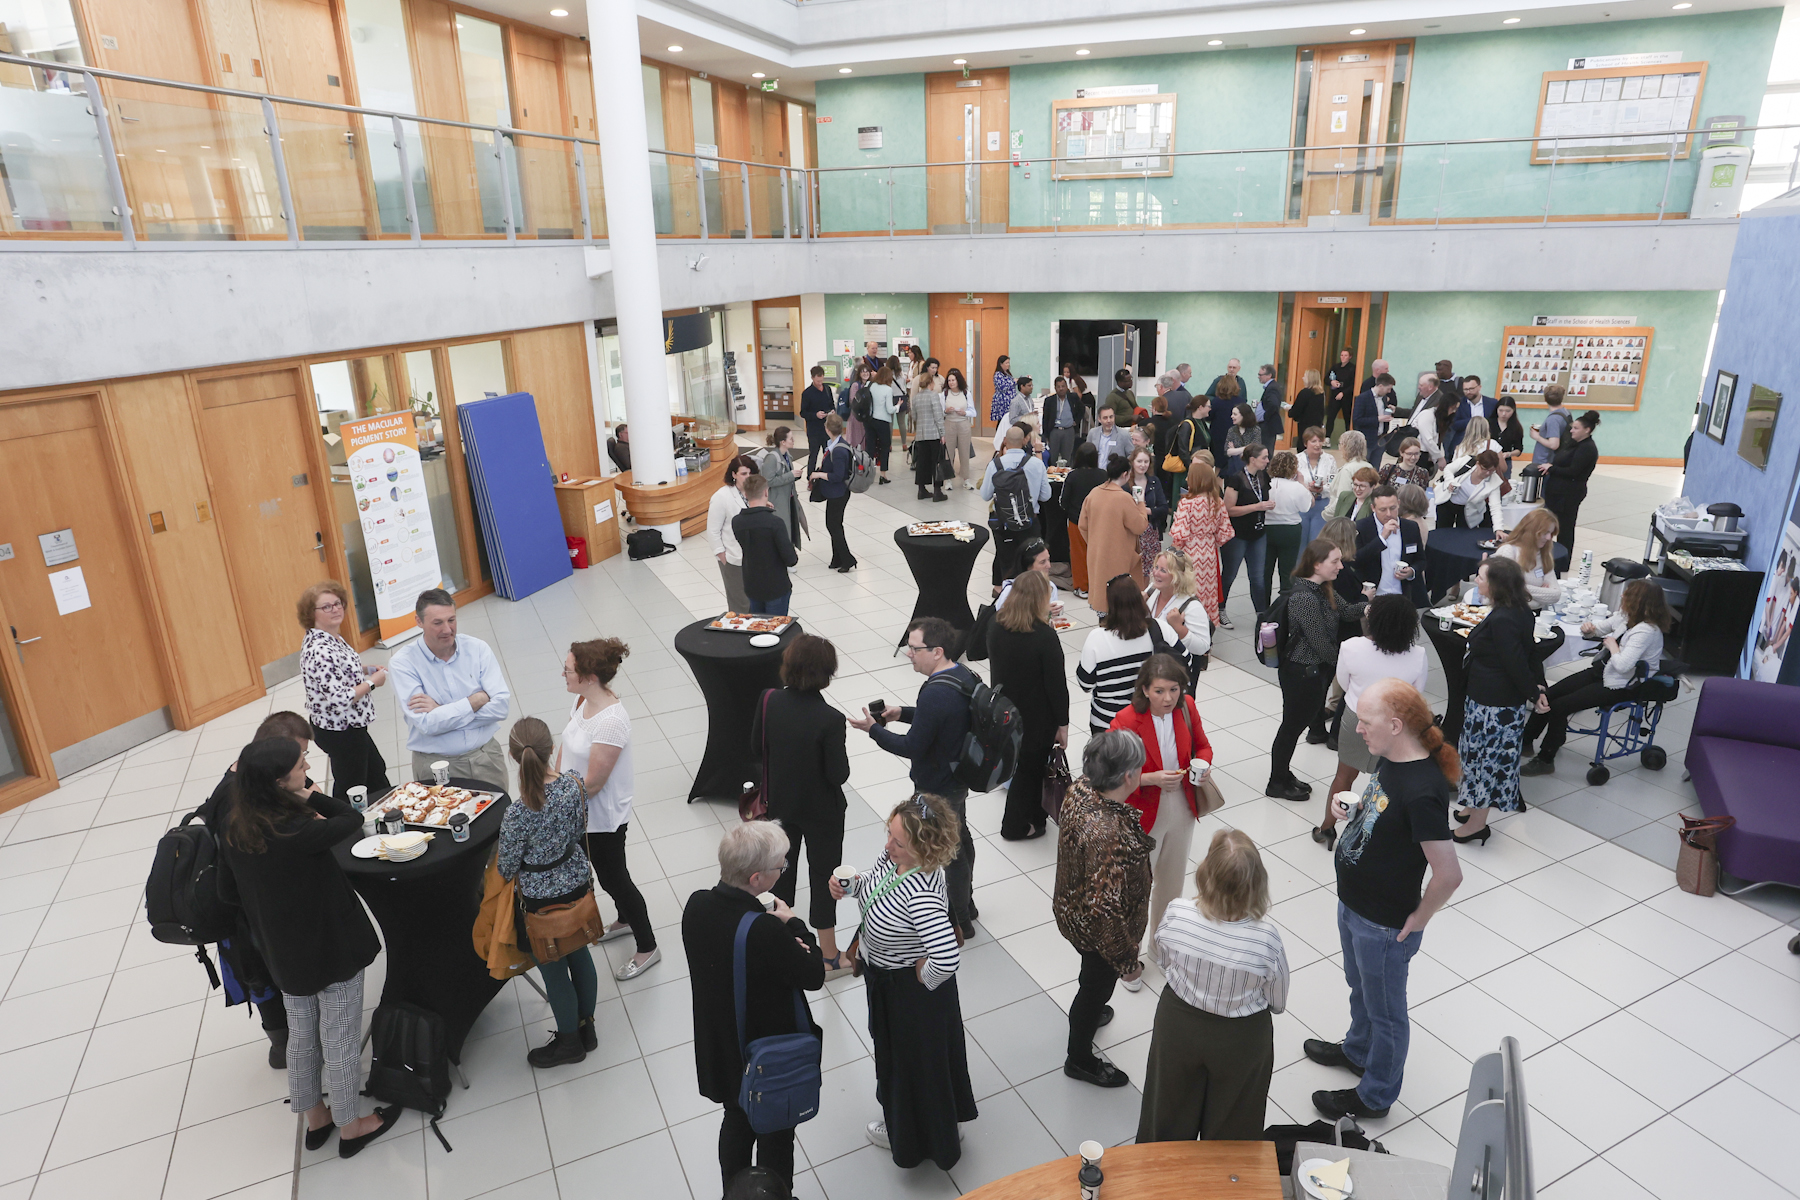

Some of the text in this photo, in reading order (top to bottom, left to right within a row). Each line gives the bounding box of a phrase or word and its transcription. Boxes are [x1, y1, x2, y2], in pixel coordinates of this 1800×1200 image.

[351, 417, 404, 435] THE MACULAR
[351, 426, 407, 447] PIGMENT STORY
